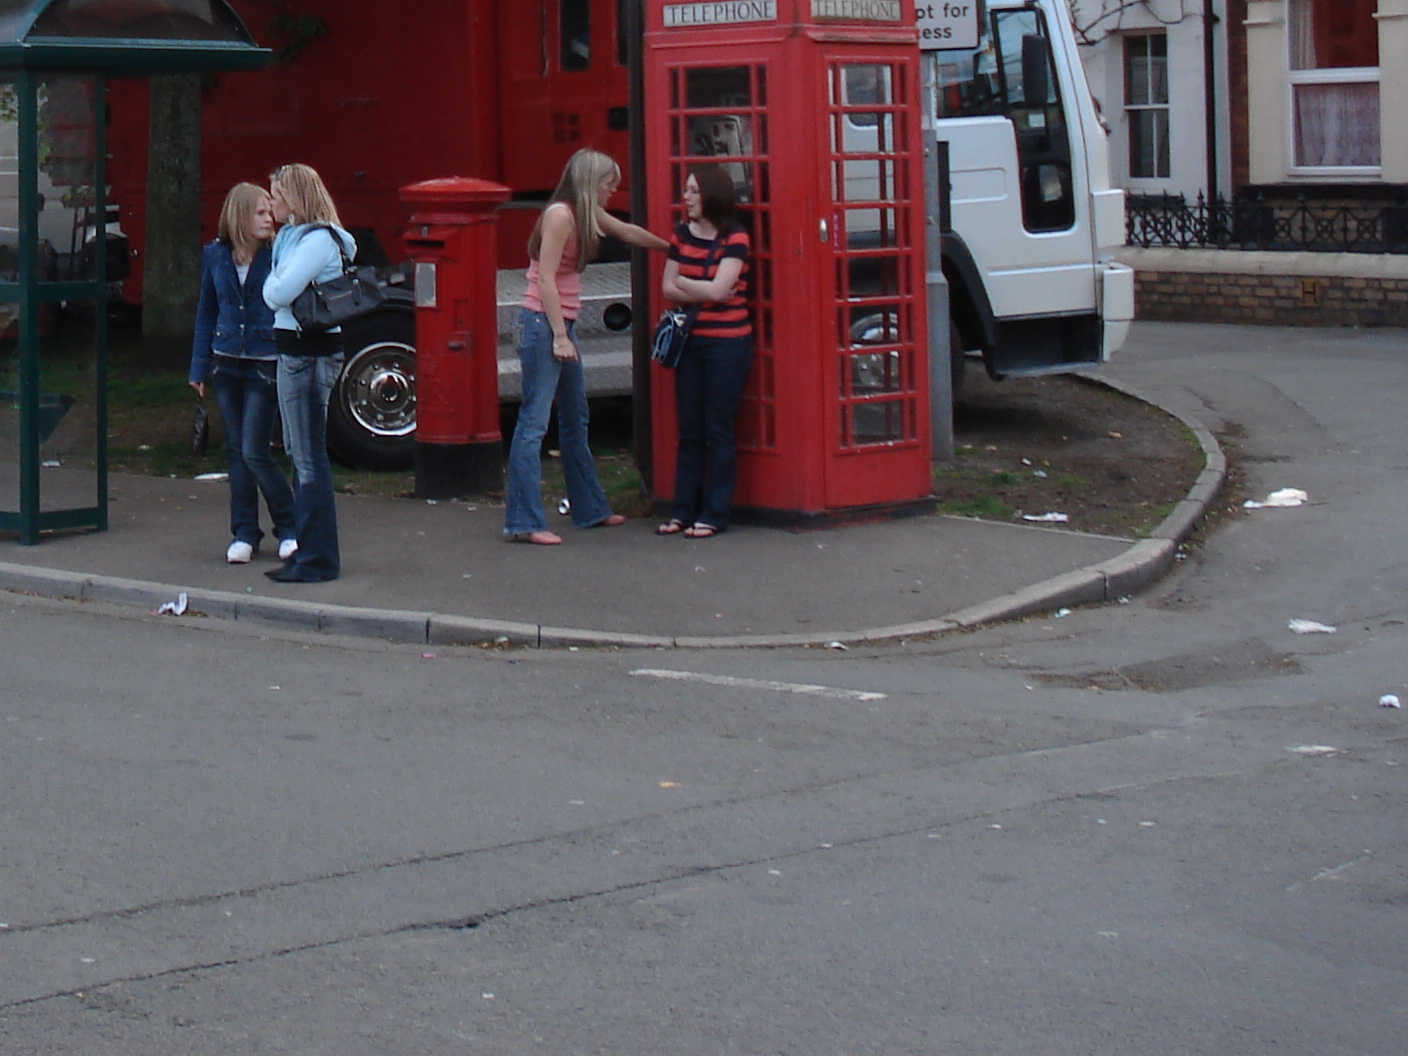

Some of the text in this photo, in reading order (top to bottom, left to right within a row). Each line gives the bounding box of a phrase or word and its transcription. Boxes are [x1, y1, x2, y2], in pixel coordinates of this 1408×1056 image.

[667, 0, 773, 24] TELEPHONE
[943, 2, 969, 18] for
[922, 27, 952, 40] ess
